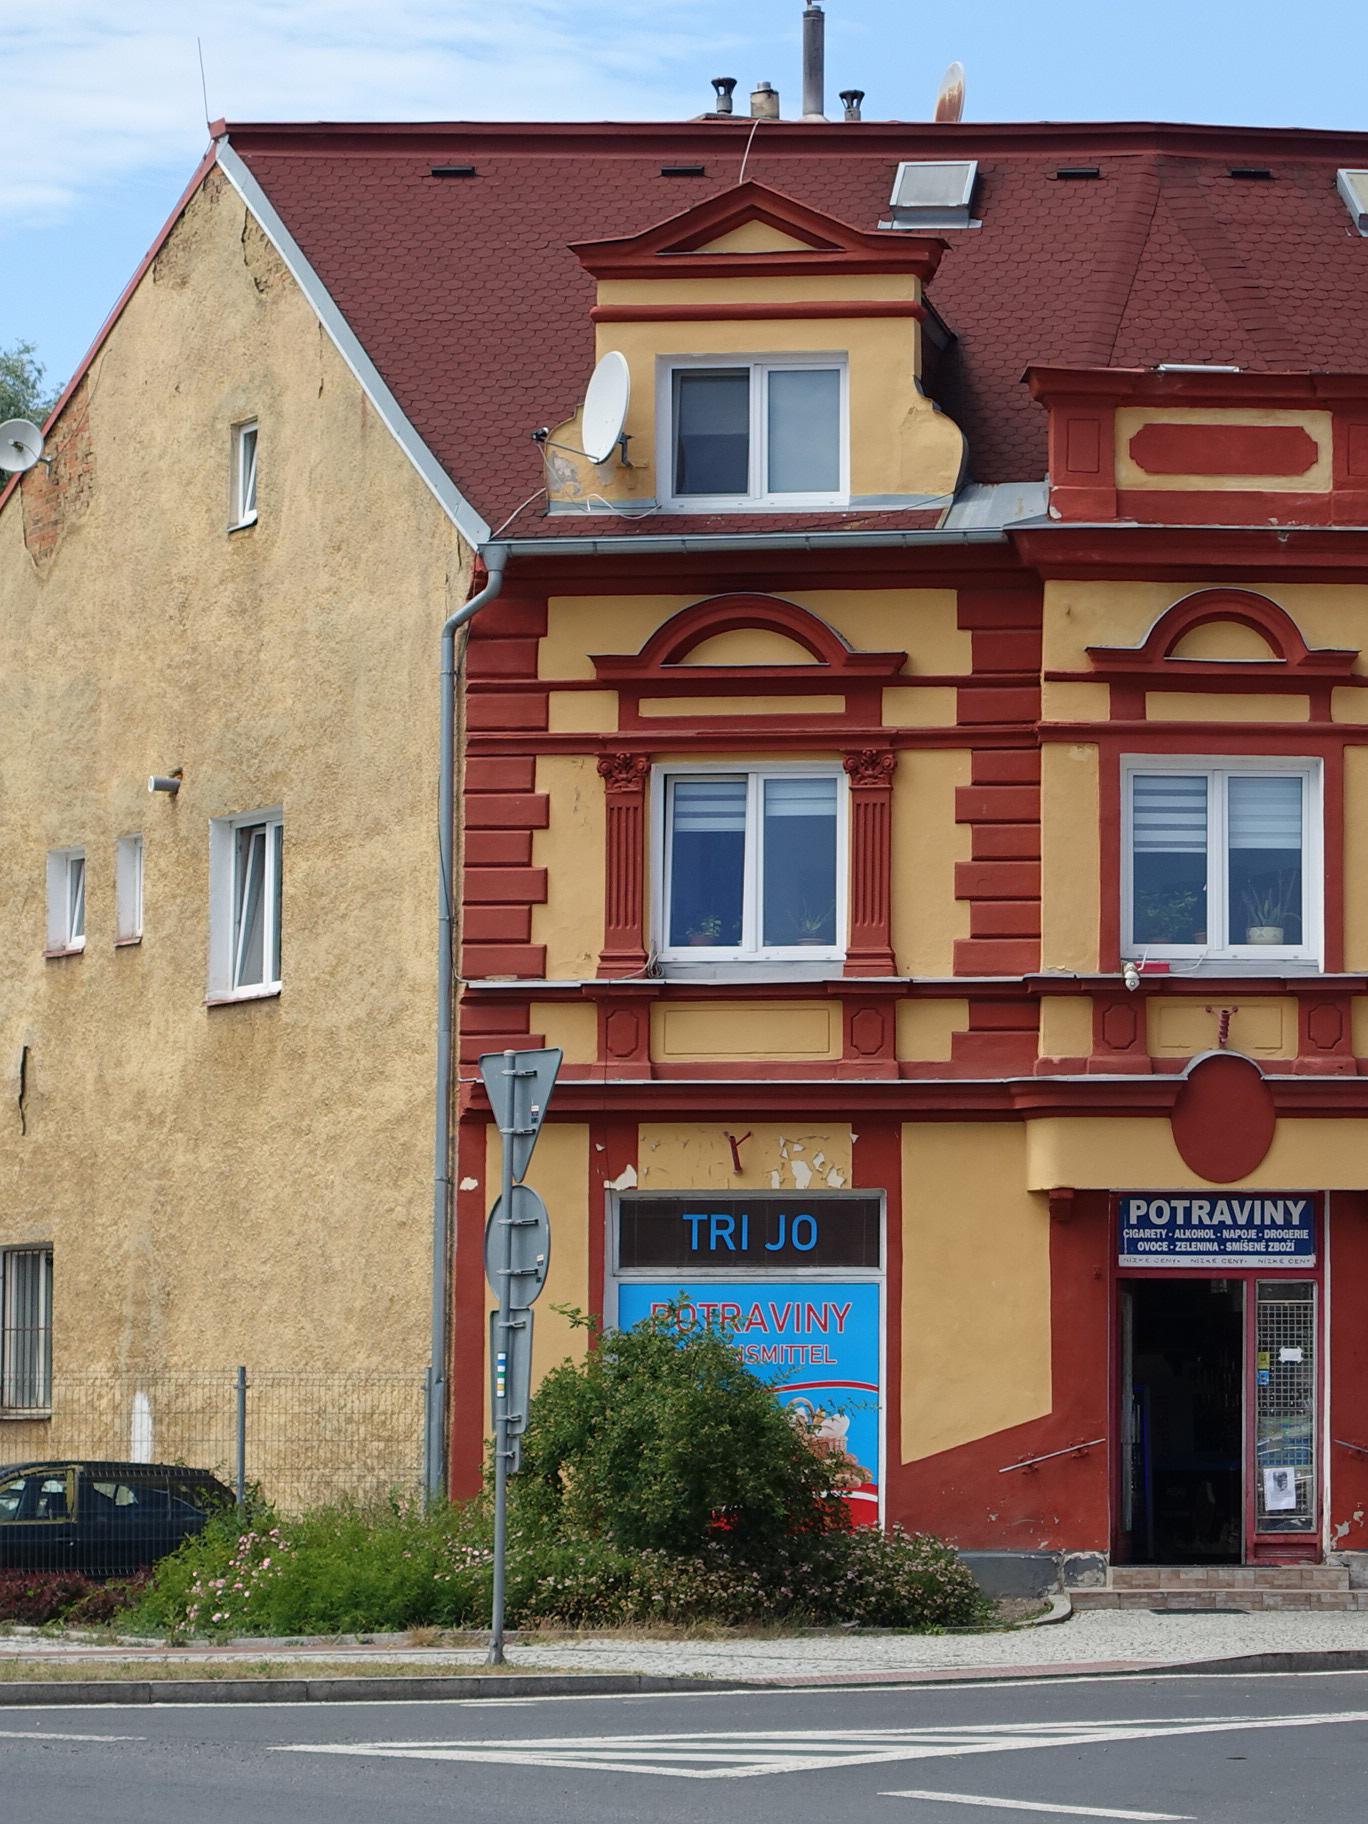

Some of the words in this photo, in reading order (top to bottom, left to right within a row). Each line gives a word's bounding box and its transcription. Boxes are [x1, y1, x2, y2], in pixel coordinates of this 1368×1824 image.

[1129, 1199, 1307, 1225] POTRAVINY
[682, 1213, 749, 1251] TRI
[764, 1213, 818, 1251] JO
[1123, 1229, 1167, 1239] CIGARETY
[1174, 1229, 1216, 1239] ALKOHOL
[1222, 1229, 1257, 1239] NAPOJE
[1264, 1229, 1309, 1239] DROGERIE
[1137, 1242, 1168, 1251] OVOCE
[1175, 1242, 1219, 1252] ZELENINA
[1226, 1239, 1266, 1252] SMÍŠENÉ
[1268, 1239, 1295, 1252] ZBOŽÍ
[651, 1302, 852, 1334] POTRAVINY
[722, 1344, 837, 1365] NSMITTEL
